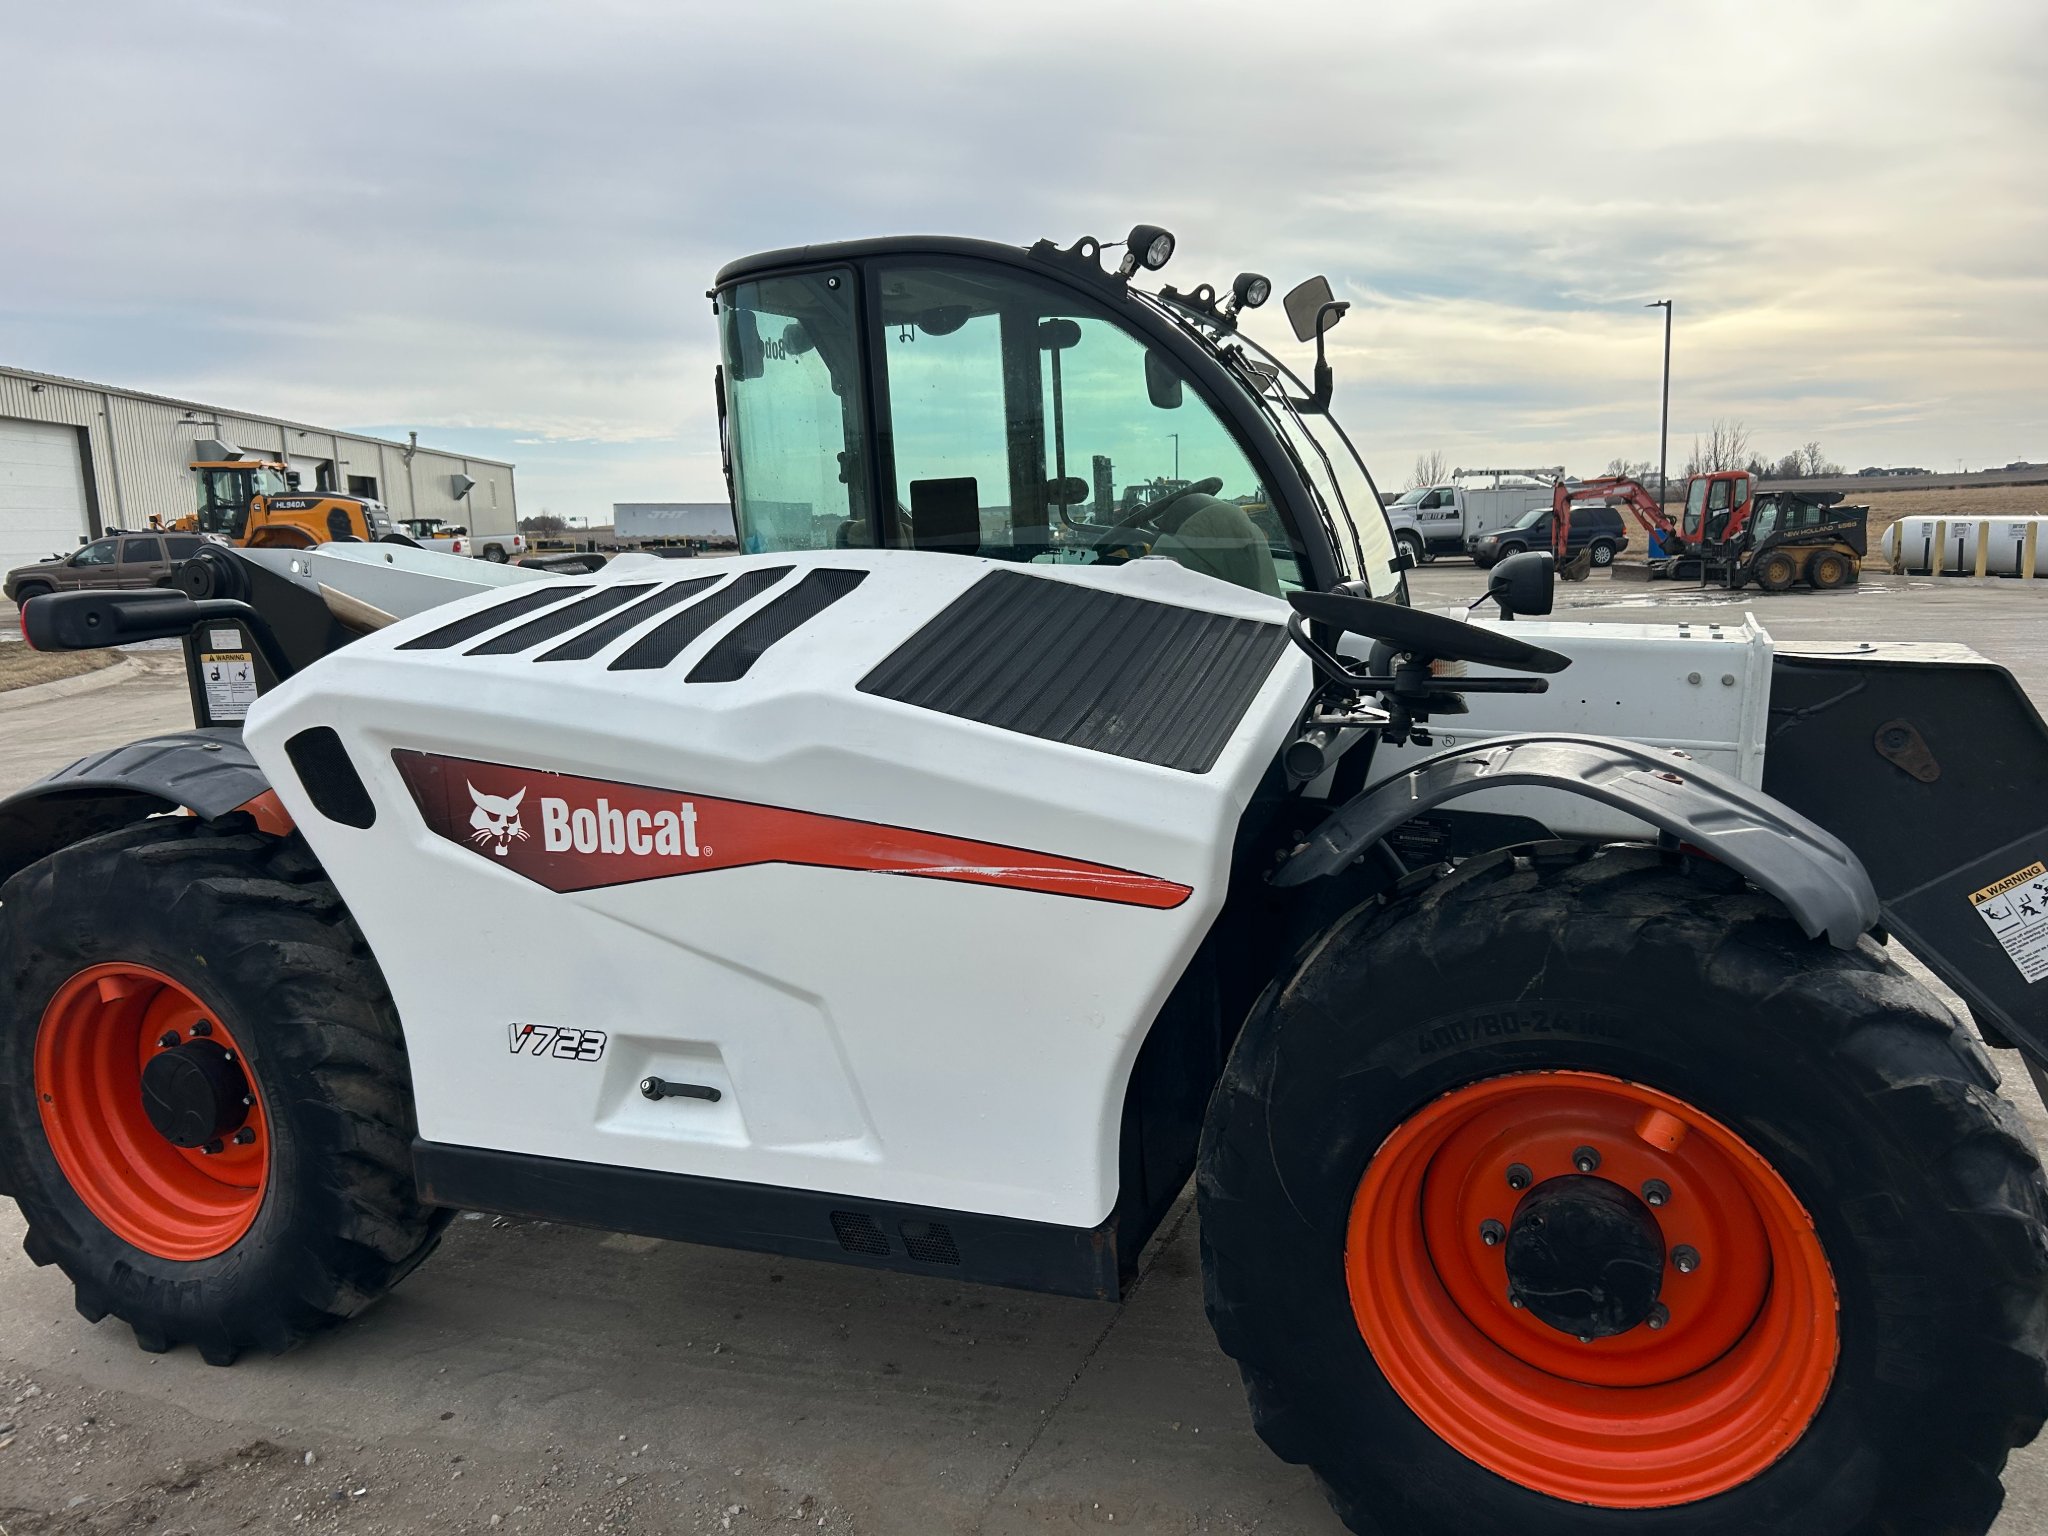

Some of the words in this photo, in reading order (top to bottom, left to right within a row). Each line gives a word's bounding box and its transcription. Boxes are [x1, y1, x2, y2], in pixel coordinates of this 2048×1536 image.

[647, 510, 689, 519] JHT
[1783, 530, 1800, 538] NEW
[1800, 525, 1834, 535] HOLLAND
[215, 653, 246, 661] WARNING
[541, 797, 700, 857] Bobcat
[1986, 865, 2042, 896] WARNING
[508, 1023, 607, 1062] V723
